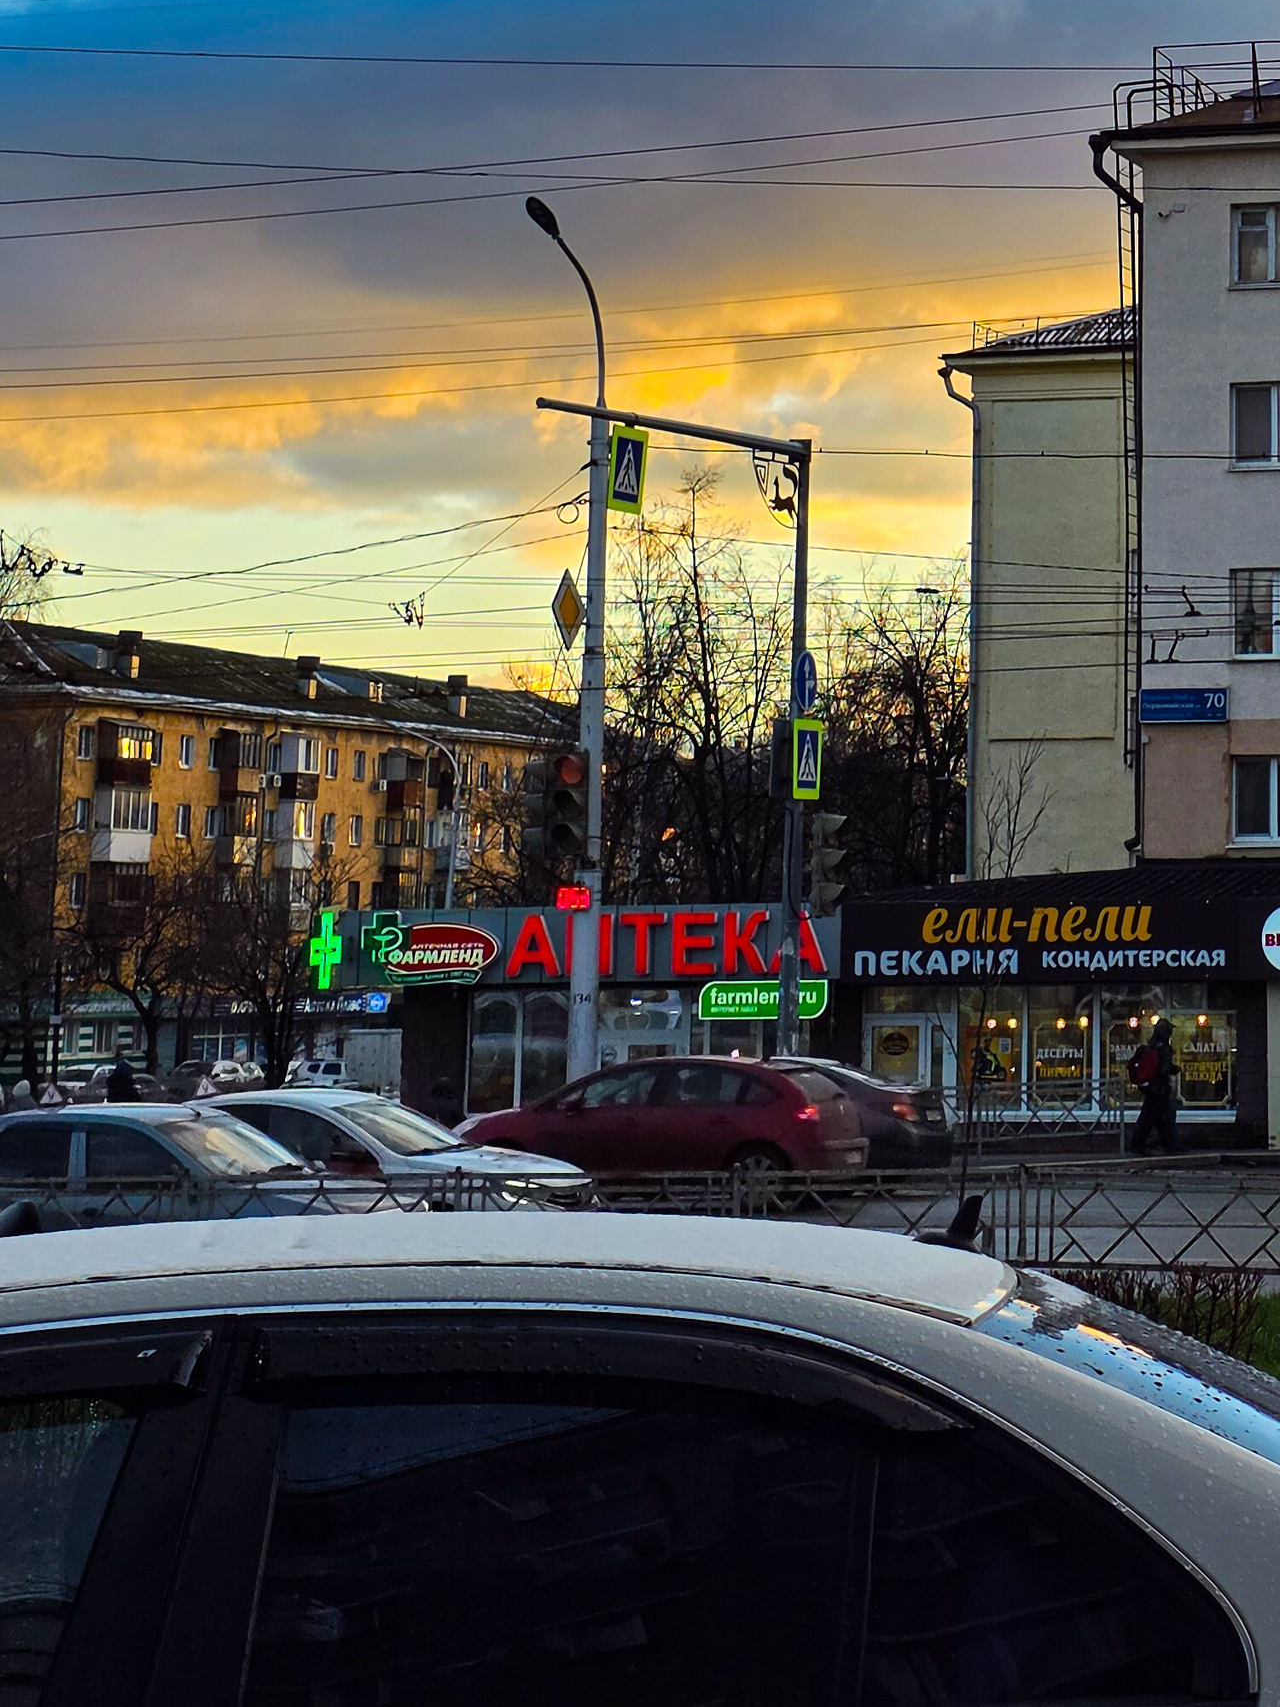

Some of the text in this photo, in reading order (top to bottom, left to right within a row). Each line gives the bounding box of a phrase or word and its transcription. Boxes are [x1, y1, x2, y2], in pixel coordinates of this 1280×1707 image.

[1204, 693, 1225, 709] 70
[922, 904, 1152, 943] ели-пели
[411, 942, 458, 950] АПТЕЧНАЯ
[388, 948, 484, 966] ФАРМЛЕНД
[854, 949, 1226, 976] ПЕКАРНЯ КОНДИТЕРСКАЯ
[1036, 1048, 1084, 1059] ДЕСЕРТЫ
[1039, 1067, 1081, 1078] ПИРОГИ
